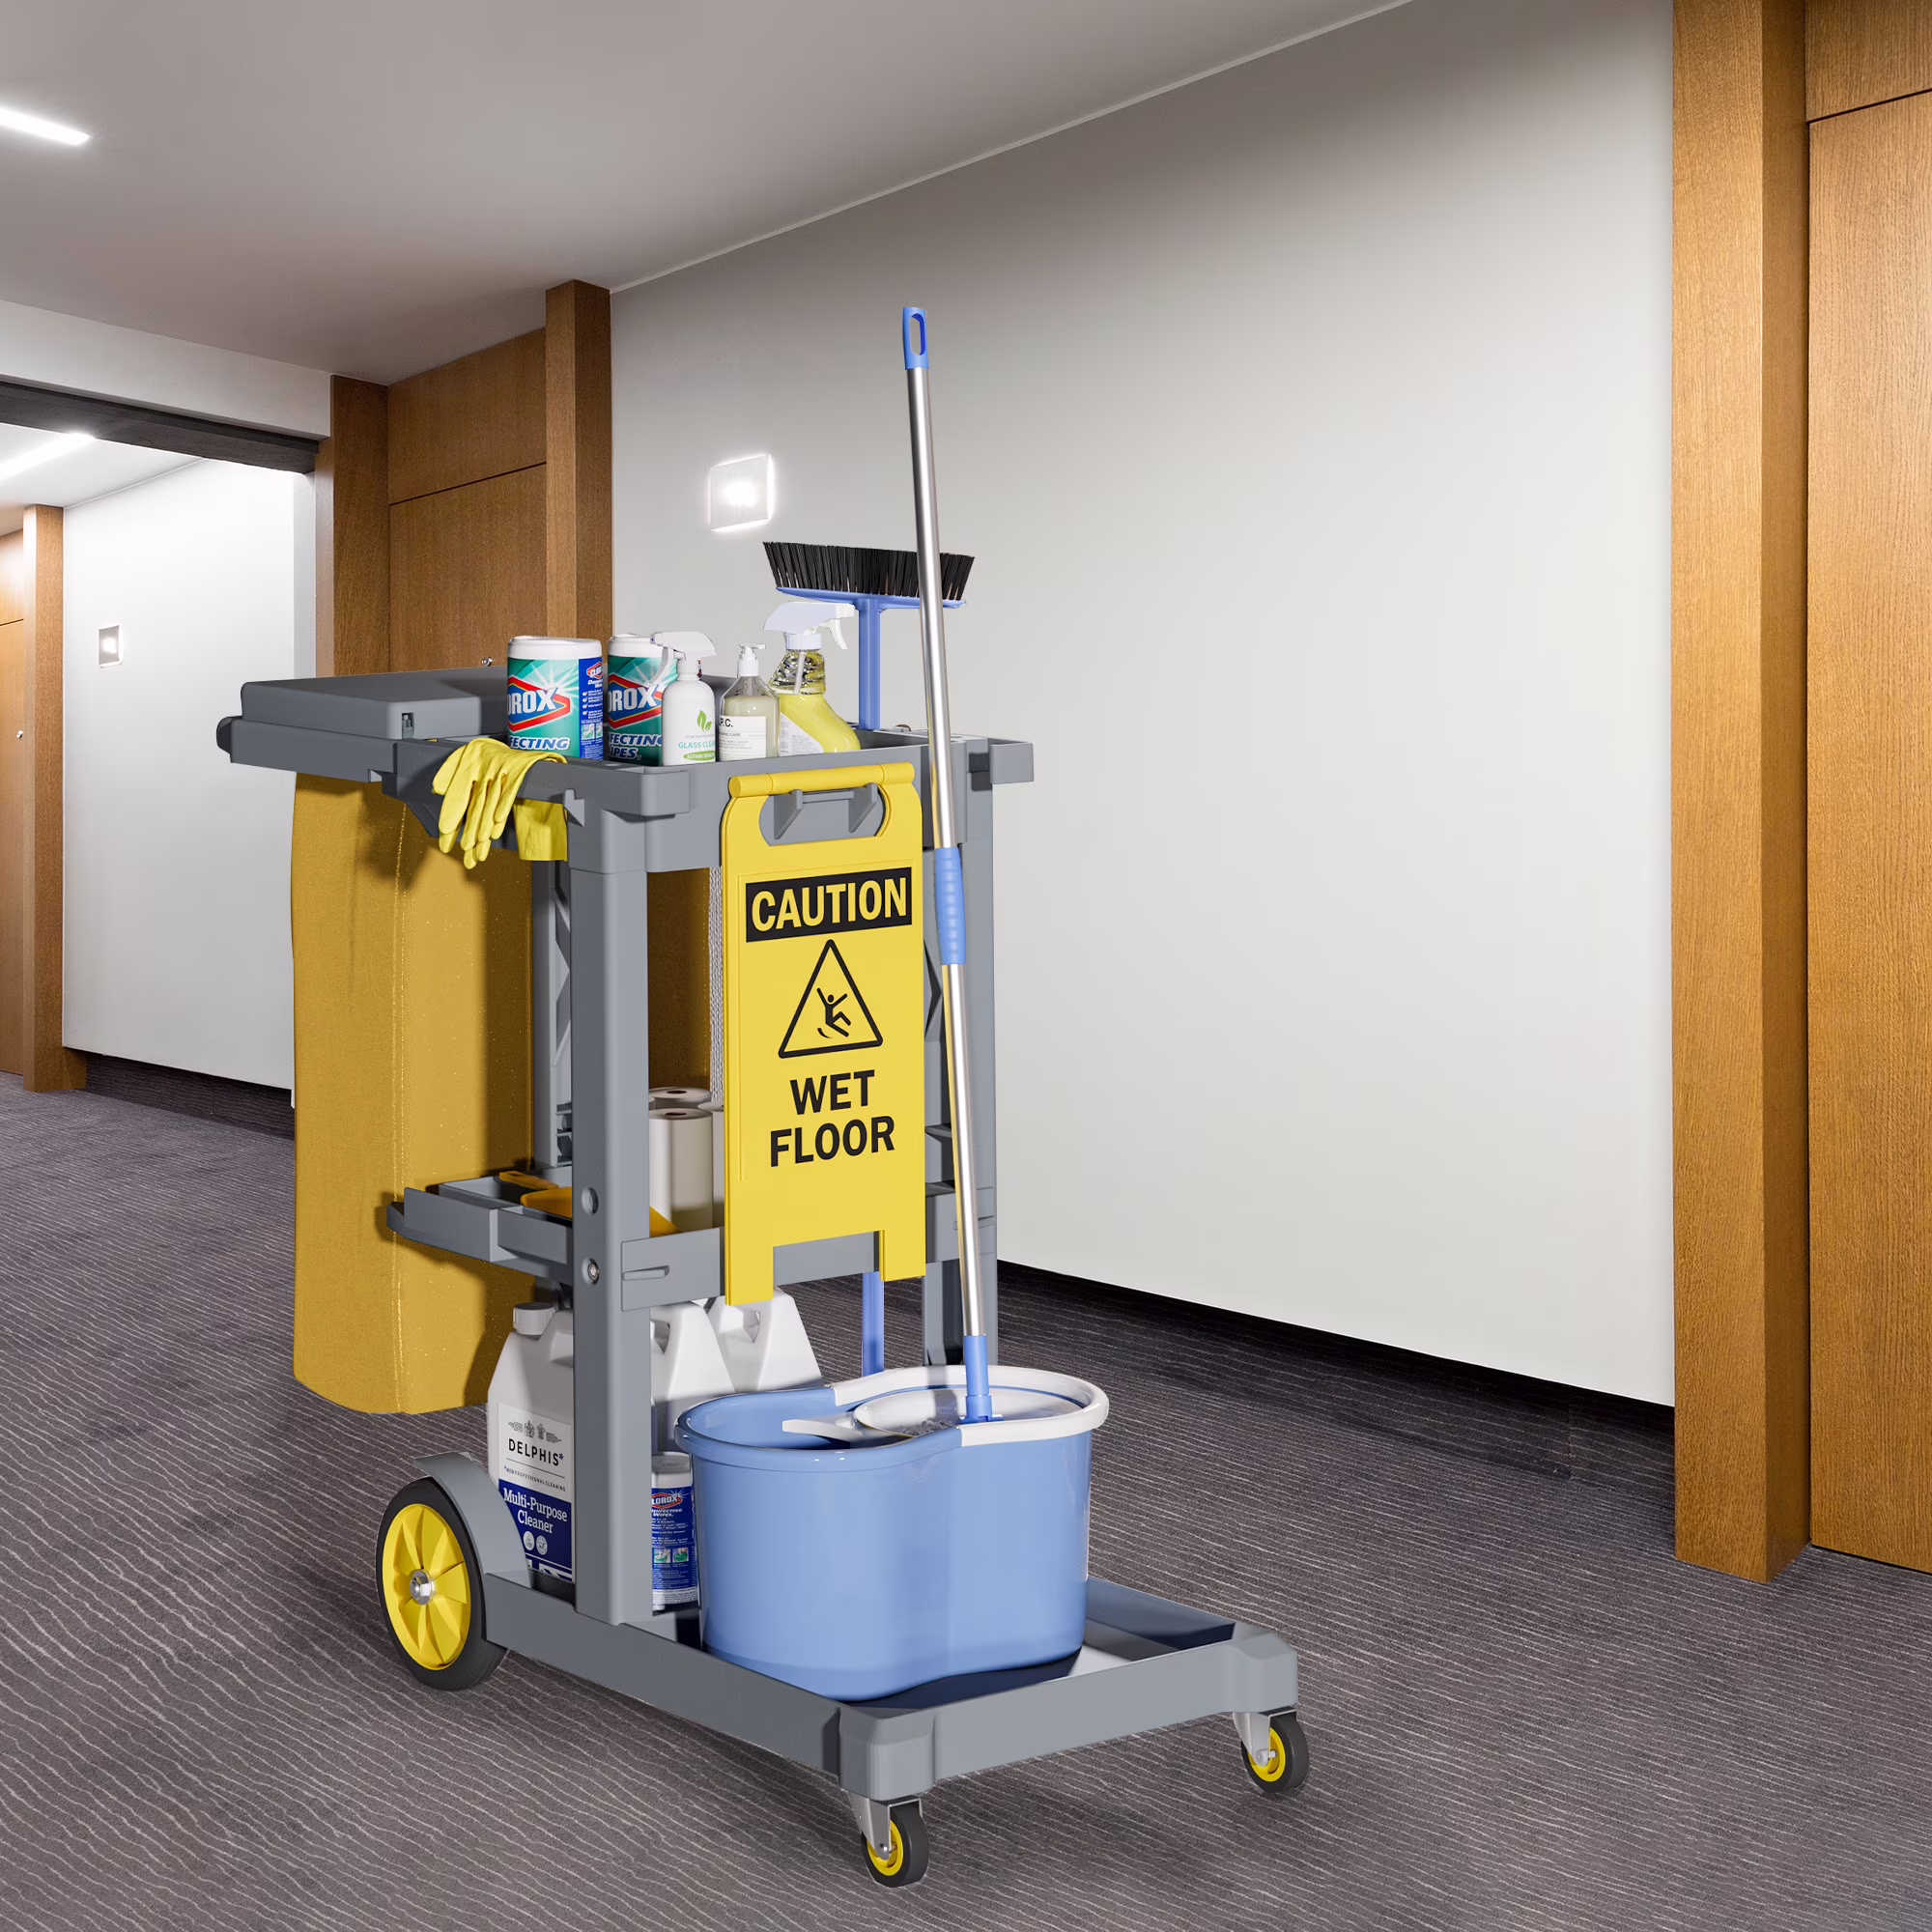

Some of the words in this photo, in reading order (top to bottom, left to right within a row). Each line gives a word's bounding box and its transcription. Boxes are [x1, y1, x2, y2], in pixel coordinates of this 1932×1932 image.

[752, 877, 908, 932] CAUTION
[789, 1069, 875, 1116] WET
[770, 1116, 895, 1168] FLOOR
[503, 1487, 568, 1522] Multi-Purpose
[517, 1509, 554, 1534] Cleaner
